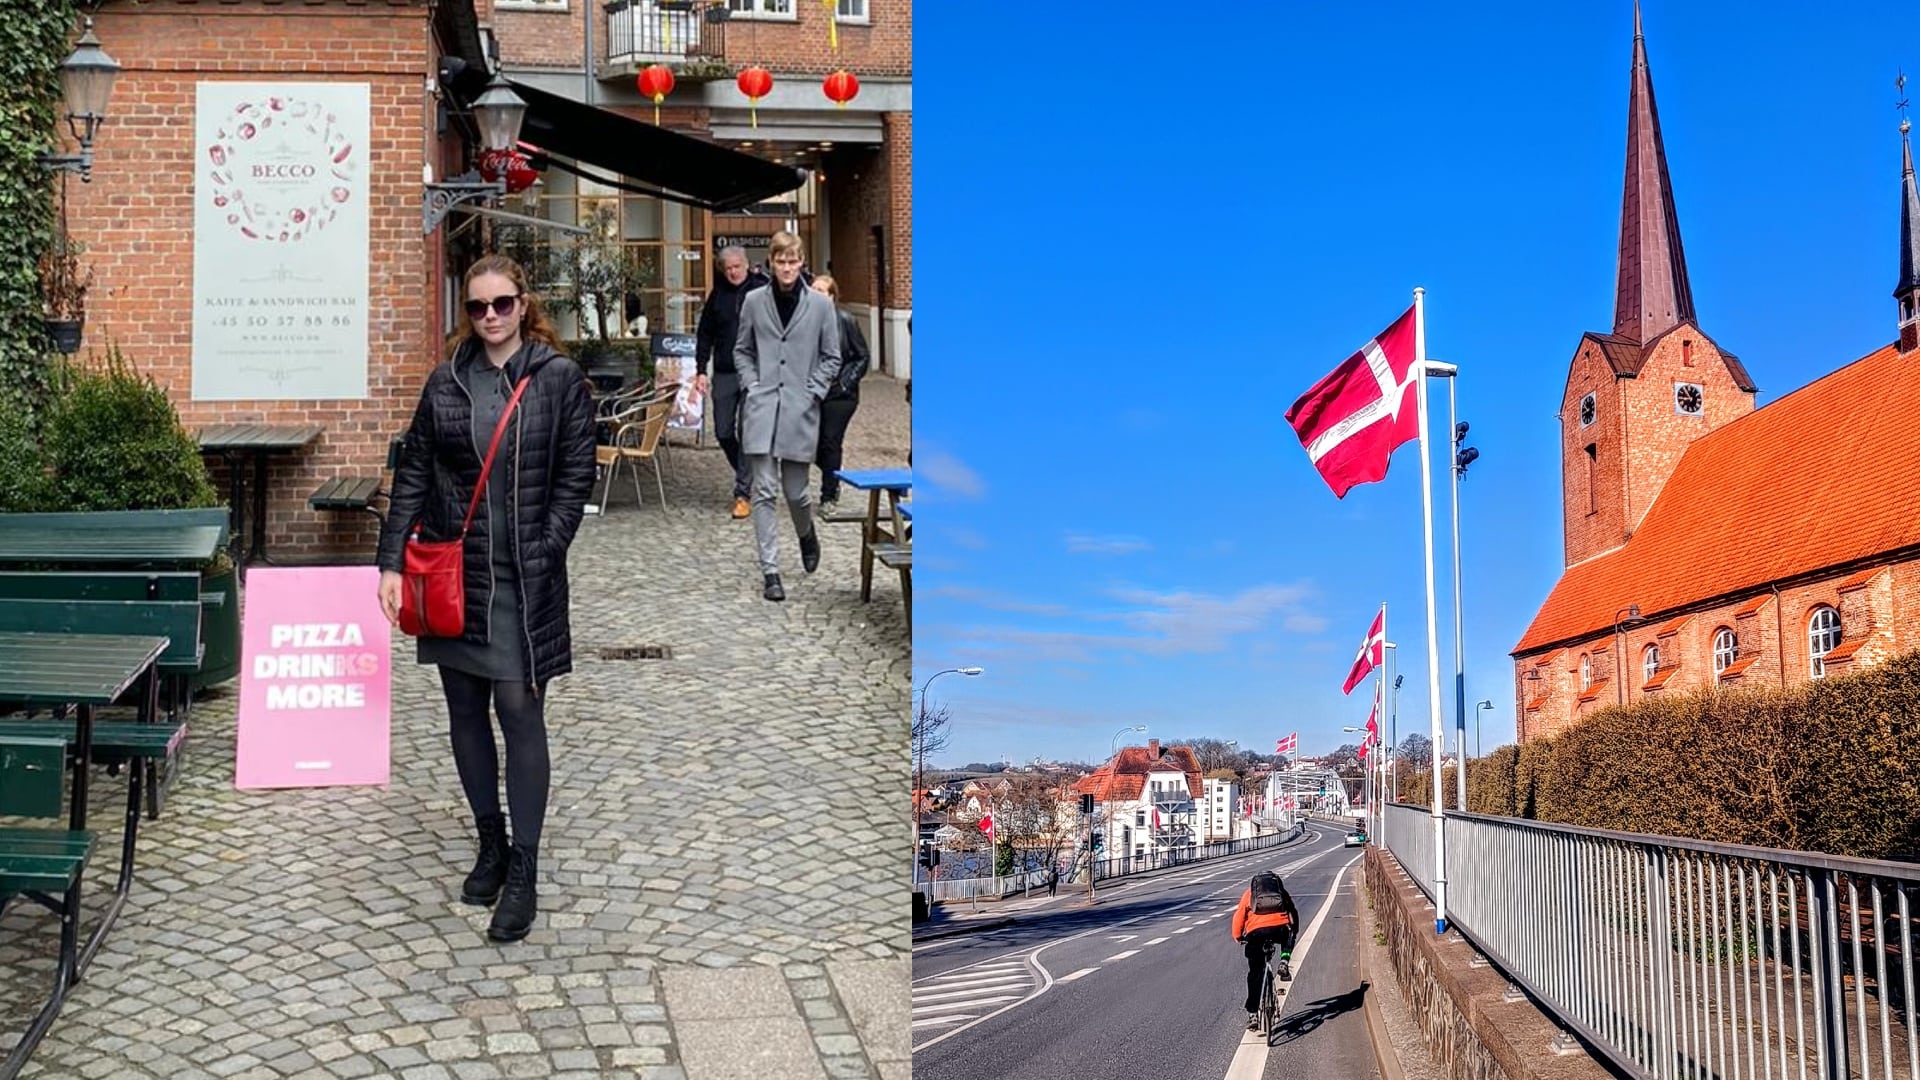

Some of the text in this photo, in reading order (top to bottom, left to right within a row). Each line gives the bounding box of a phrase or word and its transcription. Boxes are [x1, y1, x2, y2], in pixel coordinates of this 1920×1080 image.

[252, 164, 316, 177] BECCO
[263, 297, 328, 306] SANDWICH
[271, 623, 364, 648] PIZZA
[253, 653, 379, 679] DRINKS
[266, 684, 365, 710] MORE
